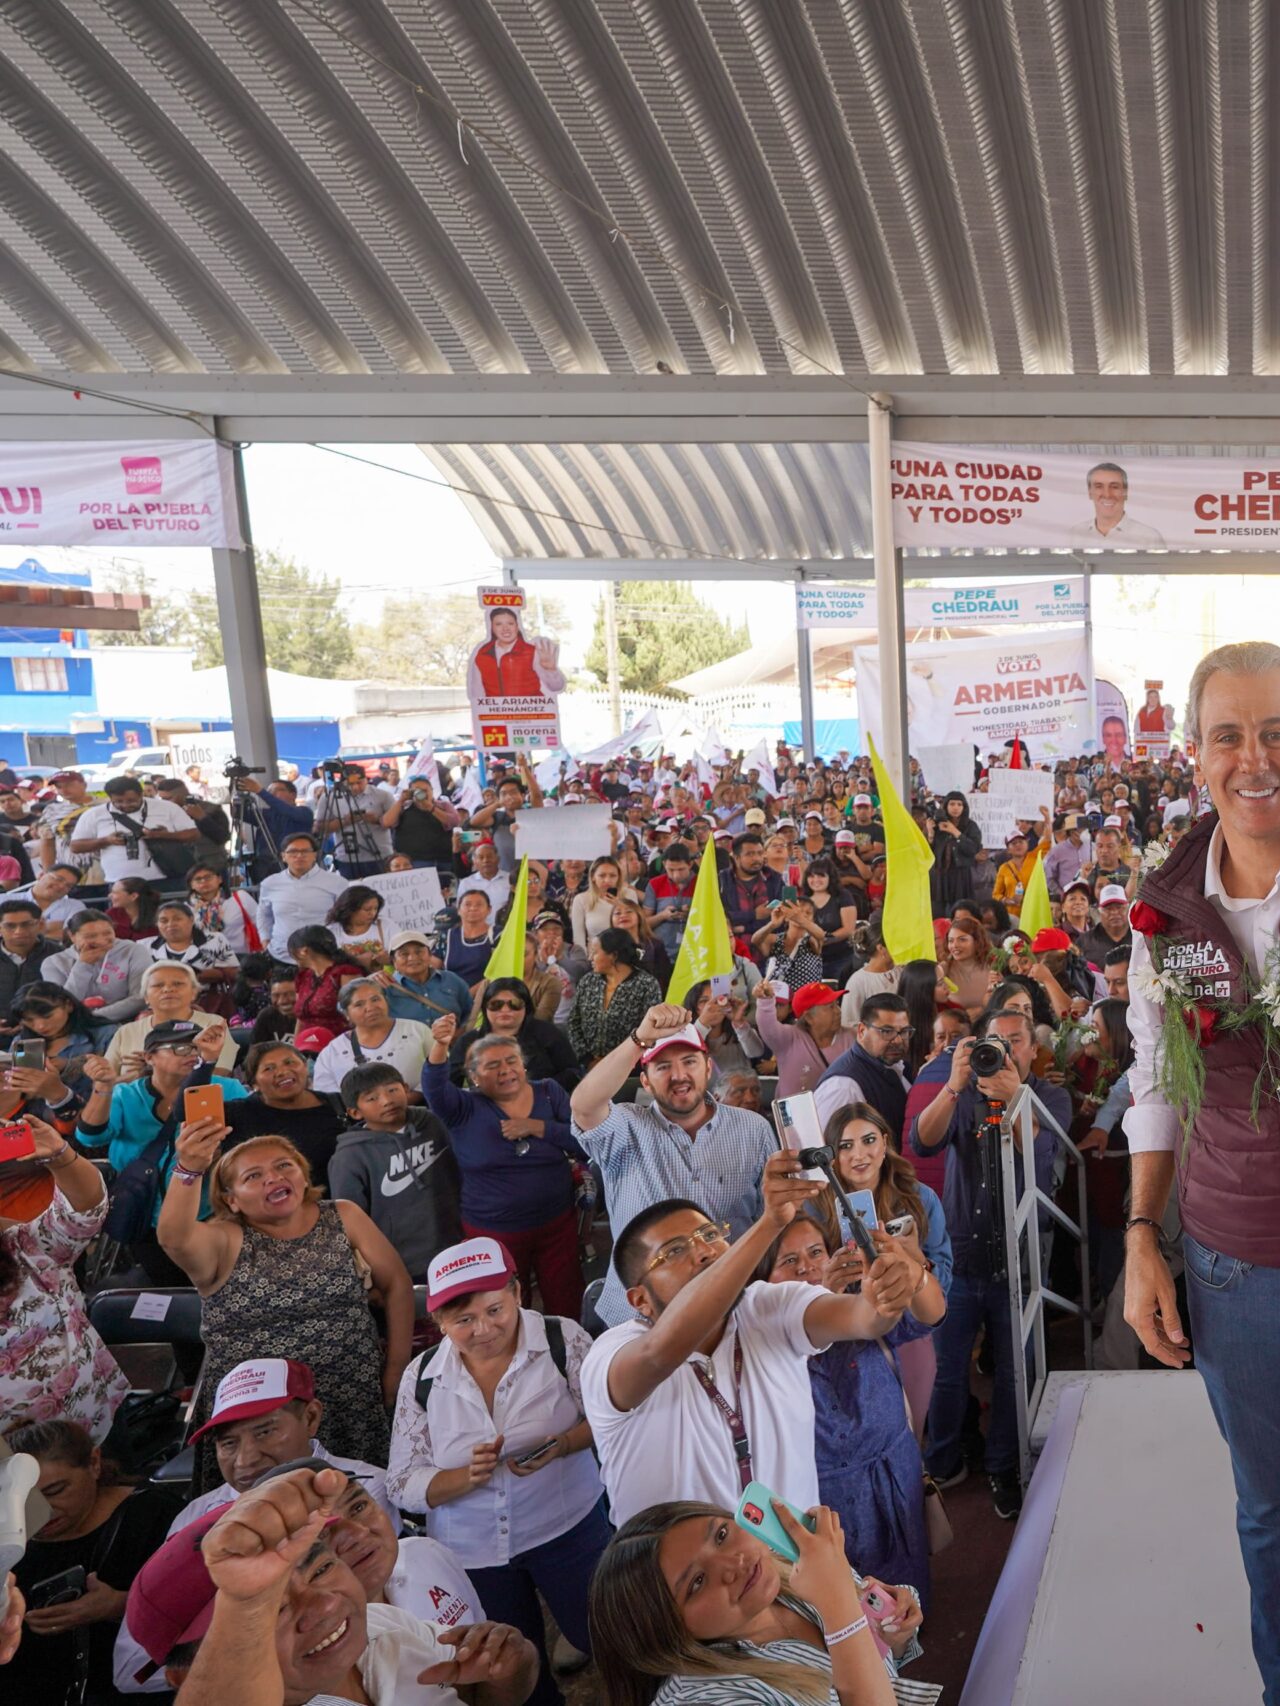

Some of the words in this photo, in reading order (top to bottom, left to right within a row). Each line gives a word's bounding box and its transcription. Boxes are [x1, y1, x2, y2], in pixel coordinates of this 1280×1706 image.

[954, 462, 1043, 481] CIUDAD
[891, 483, 953, 501] PARA
[959, 484, 1040, 503] TODAS
[0, 487, 42, 514] UI
[79, 502, 113, 515] POR
[117, 503, 141, 515] LA
[144, 502, 212, 515] PUEBLA
[908, 506, 923, 523] Y
[929, 507, 1023, 525] TODOS”
[93, 519, 129, 530] DEL
[133, 518, 200, 531] FUTURO
[483, 596, 522, 604] VOTA
[826, 591, 865, 599] CIUDAD
[954, 589, 996, 600] PEPE
[830, 601, 864, 609] TODAS
[931, 599, 1019, 613] CHEDRAUI
[998, 659, 1041, 673] VOTA
[954, 672, 1088, 706] ARMENTA
[983, 699, 1062, 716] GOBERNADOR
[512, 727, 556, 735] morena
[972, 720, 1029, 732] HONESTIDAD,
[484, 733, 506, 745] PT
[173, 744, 213, 765] Todos
[1167, 943, 1194, 957] POR
[1196, 940, 1213, 952] LA
[1163, 948, 1226, 969] PUEBLA
[1216, 987, 1228, 996] PT
[390, 1140, 434, 1177] NIKE
[435, 1252, 492, 1279] ARMENTA
